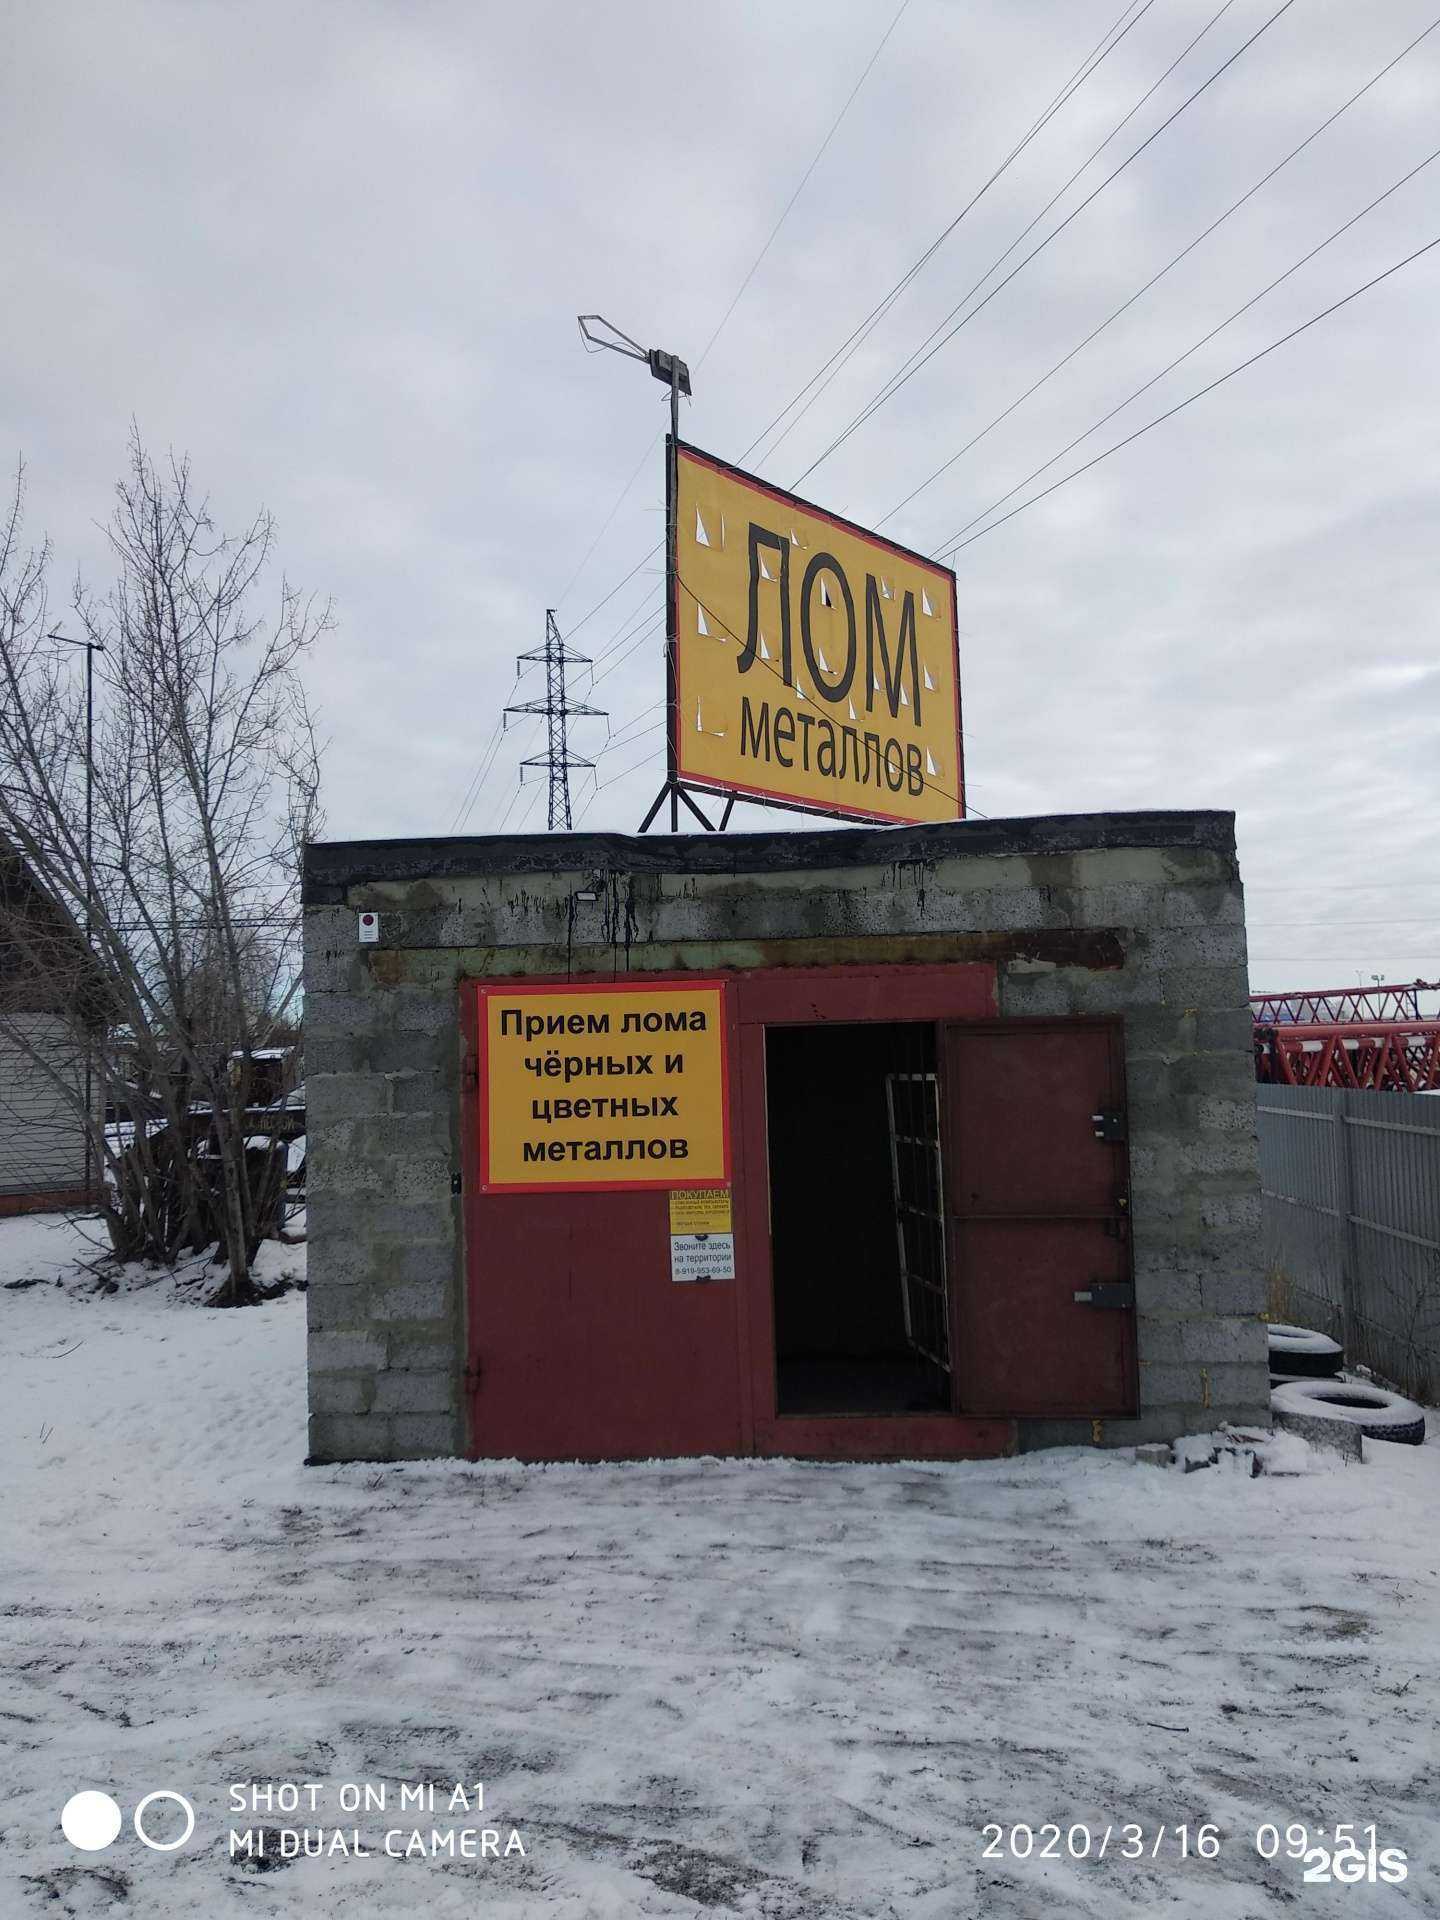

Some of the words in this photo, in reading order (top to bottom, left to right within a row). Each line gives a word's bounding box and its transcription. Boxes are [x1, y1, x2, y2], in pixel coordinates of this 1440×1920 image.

[737, 522, 922, 727] ЛОМ
[740, 696, 924, 796] металлов
[501, 1009, 610, 1041] Прием
[620, 1011, 707, 1033] лома
[524, 1050, 653, 1083] чёрных
[664, 1054, 683, 1074] и
[532, 1096, 679, 1124] цветных
[523, 1138, 689, 1162] металлов
[671, 1190, 729, 1200] ПОКУПАЕМ
[674, 1241, 706, 1251] Звоните
